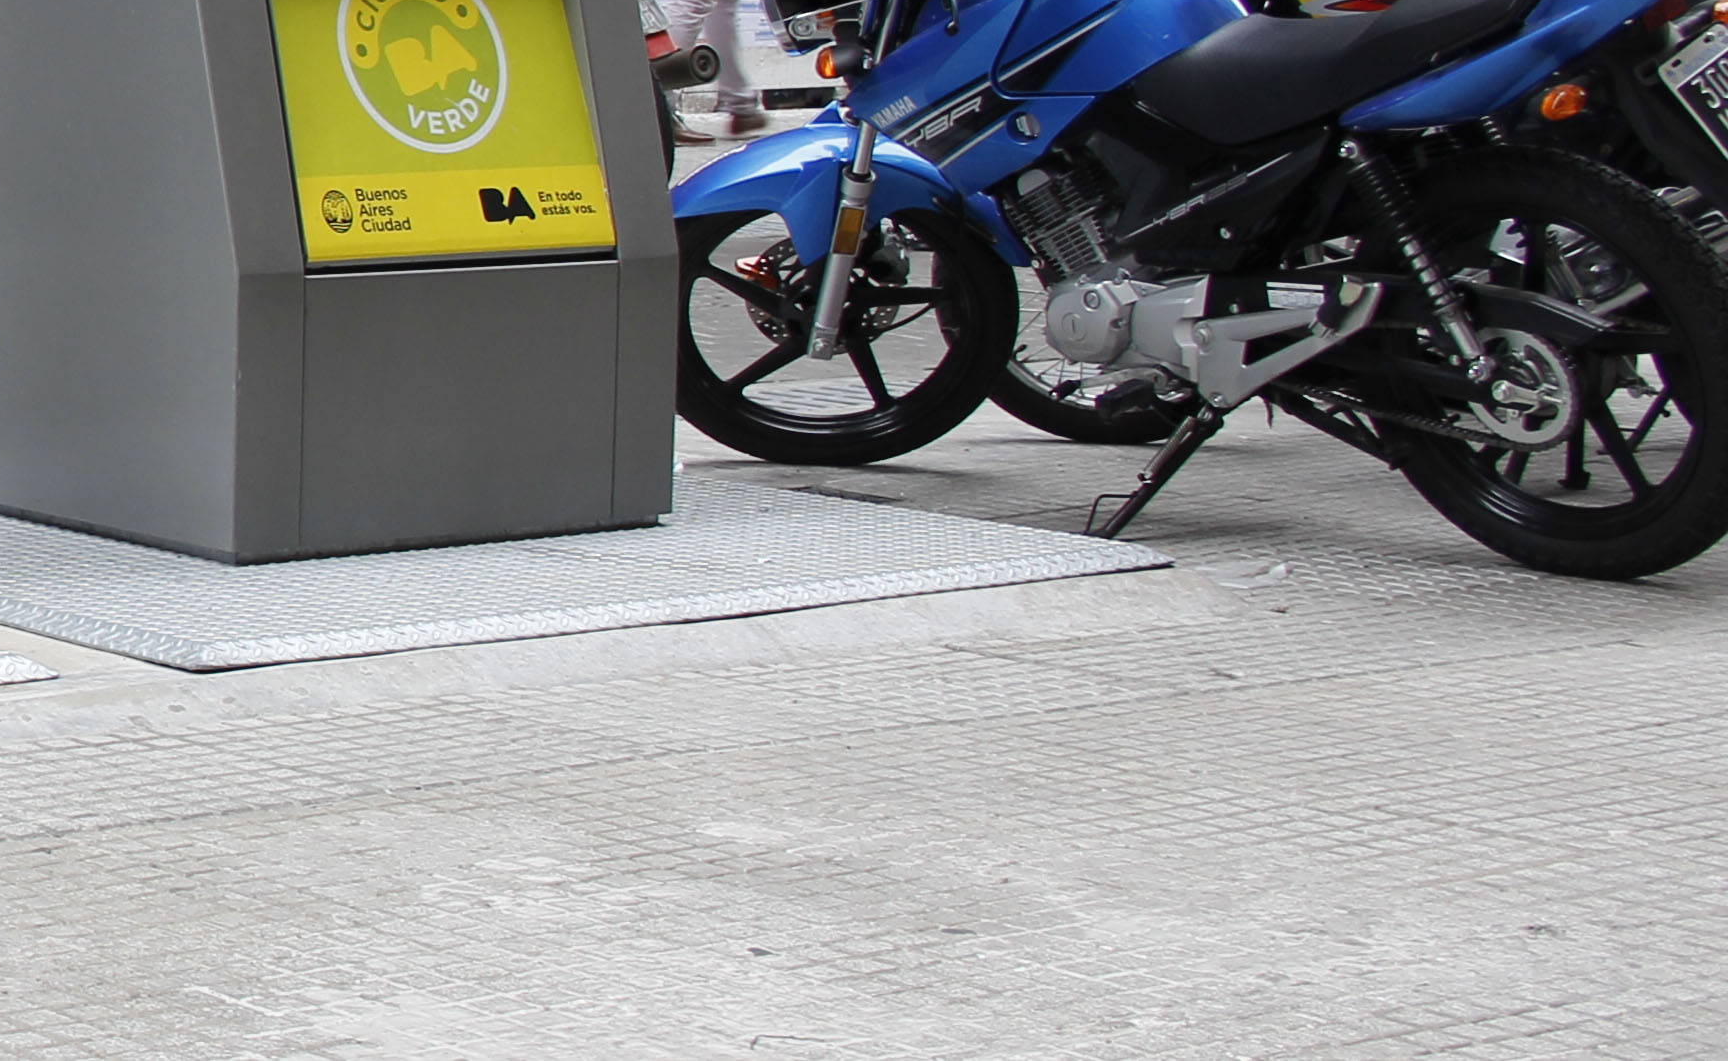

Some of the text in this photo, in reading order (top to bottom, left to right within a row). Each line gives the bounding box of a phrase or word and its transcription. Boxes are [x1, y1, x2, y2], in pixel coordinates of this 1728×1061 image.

[407, 79, 490, 135] VERDE
[871, 95, 917, 128] YAMAHA
[904, 96, 982, 147] YBR
[355, 188, 407, 203] Buenos
[538, 190, 582, 203] En todo
[359, 204, 394, 218] Aires
[542, 204, 597, 215] estás vos.
[361, 217, 411, 232] Ciudad
